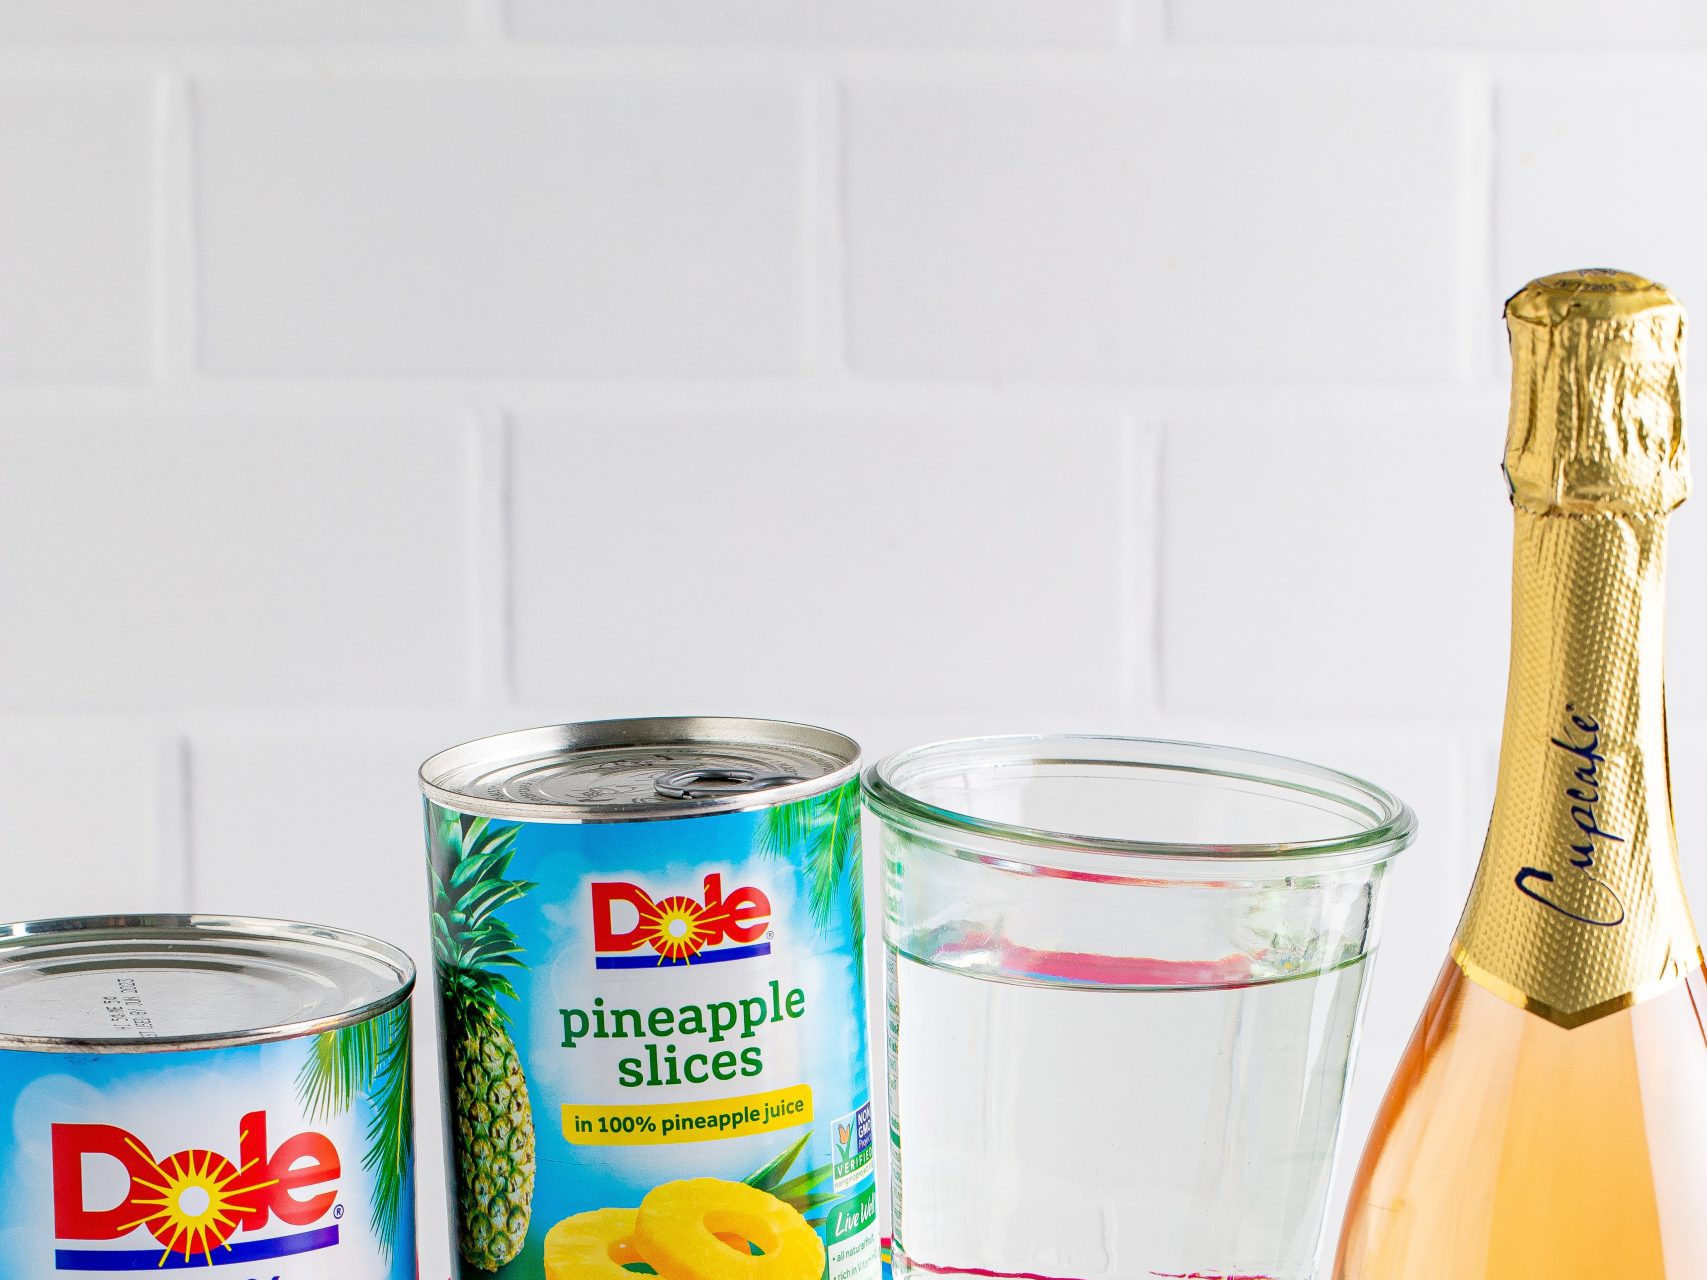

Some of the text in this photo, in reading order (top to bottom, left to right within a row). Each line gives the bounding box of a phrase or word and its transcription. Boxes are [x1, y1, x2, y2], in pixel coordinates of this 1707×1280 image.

[1514, 712, 1625, 927] Cupcake
[591, 873, 771, 960] Dole
[559, 980, 805, 1047] pineapple
[619, 1043, 763, 1088] slices
[575, 1100, 805, 1136] in 100% pineapple juice
[51, 1110, 342, 1254] Dole
[836, 1211, 859, 1237] Live
[846, 1241, 866, 1258] natural
[838, 1268, 850, 1280] rich
